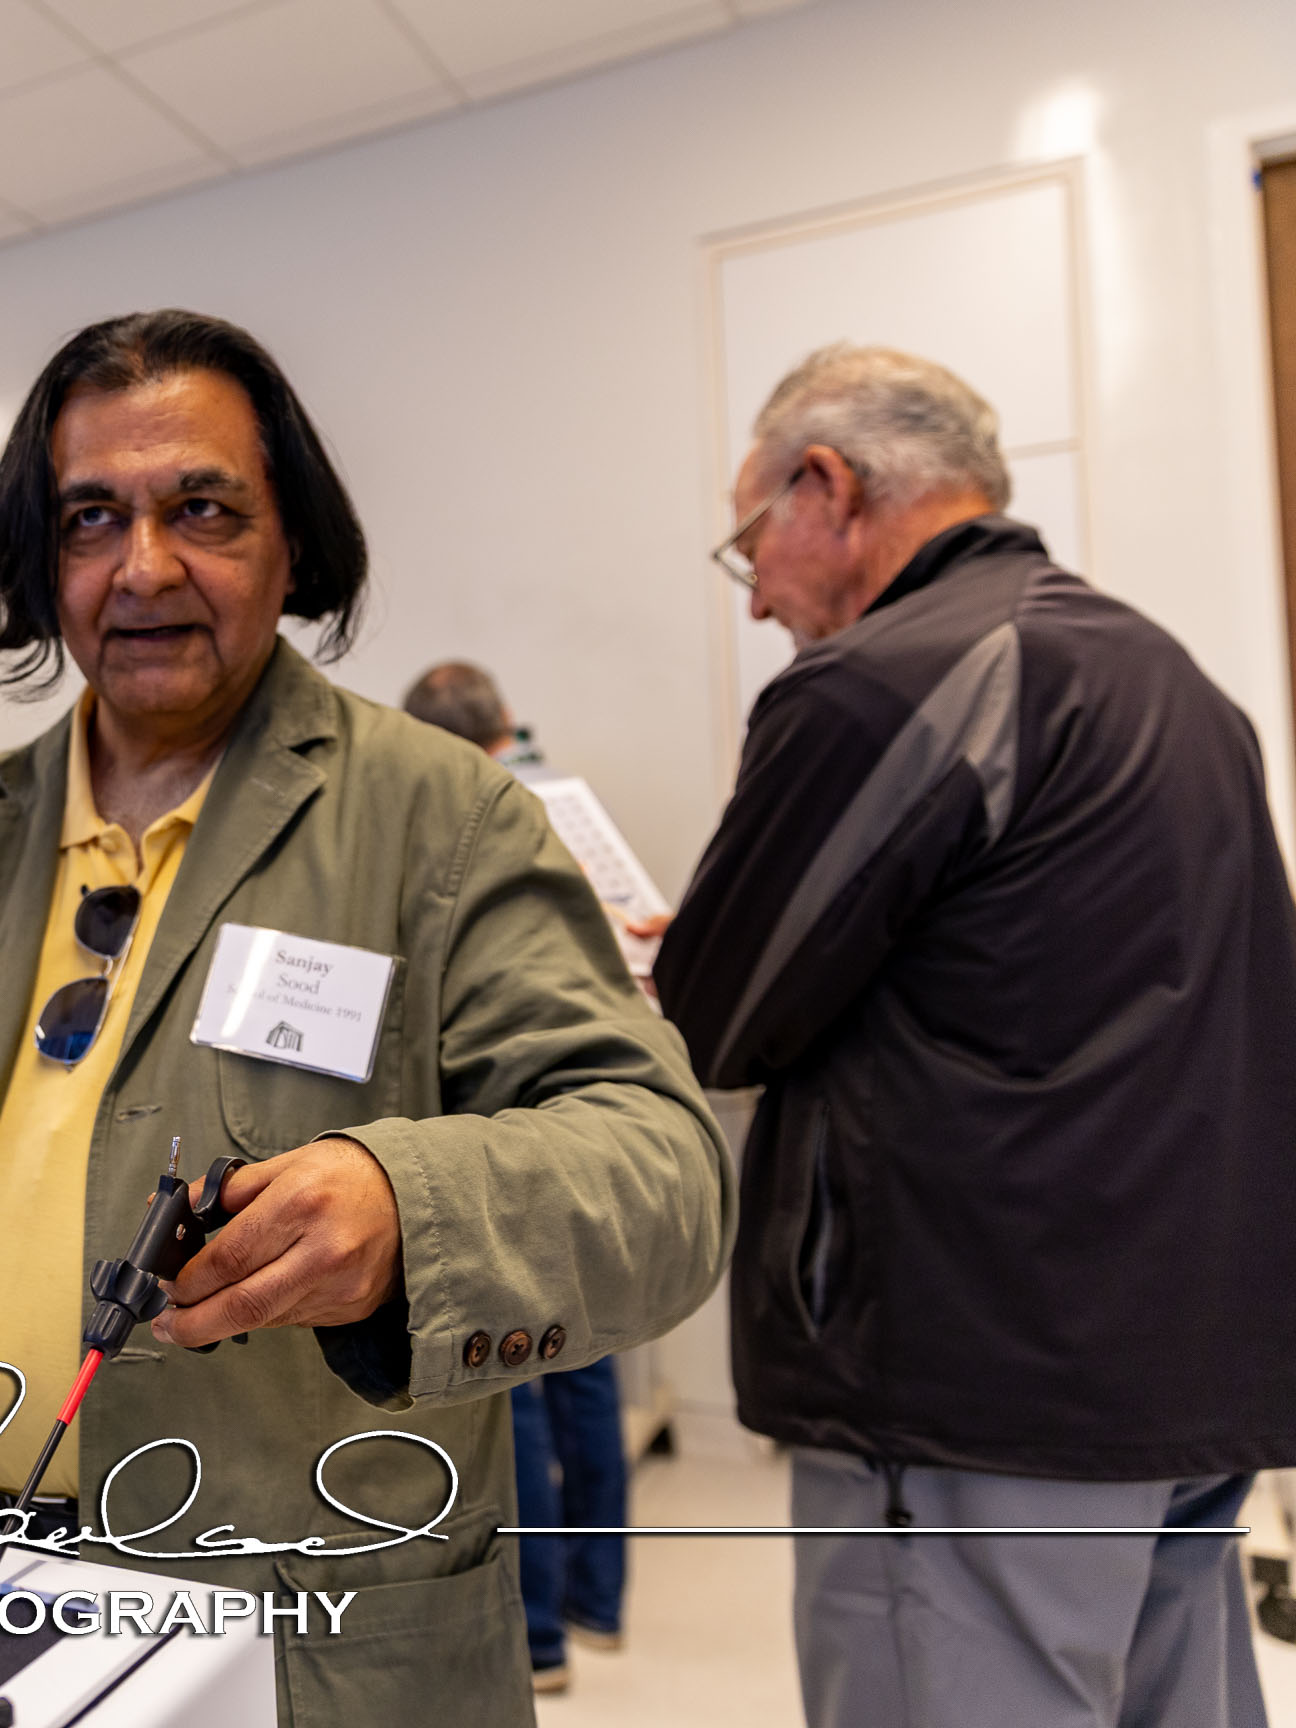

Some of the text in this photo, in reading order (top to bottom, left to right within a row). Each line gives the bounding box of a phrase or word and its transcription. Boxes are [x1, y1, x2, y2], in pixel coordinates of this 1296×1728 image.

[275, 950, 334, 977] Sanjay
[277, 973, 321, 995] Sood
[282, 995, 333, 1016] Medicine
